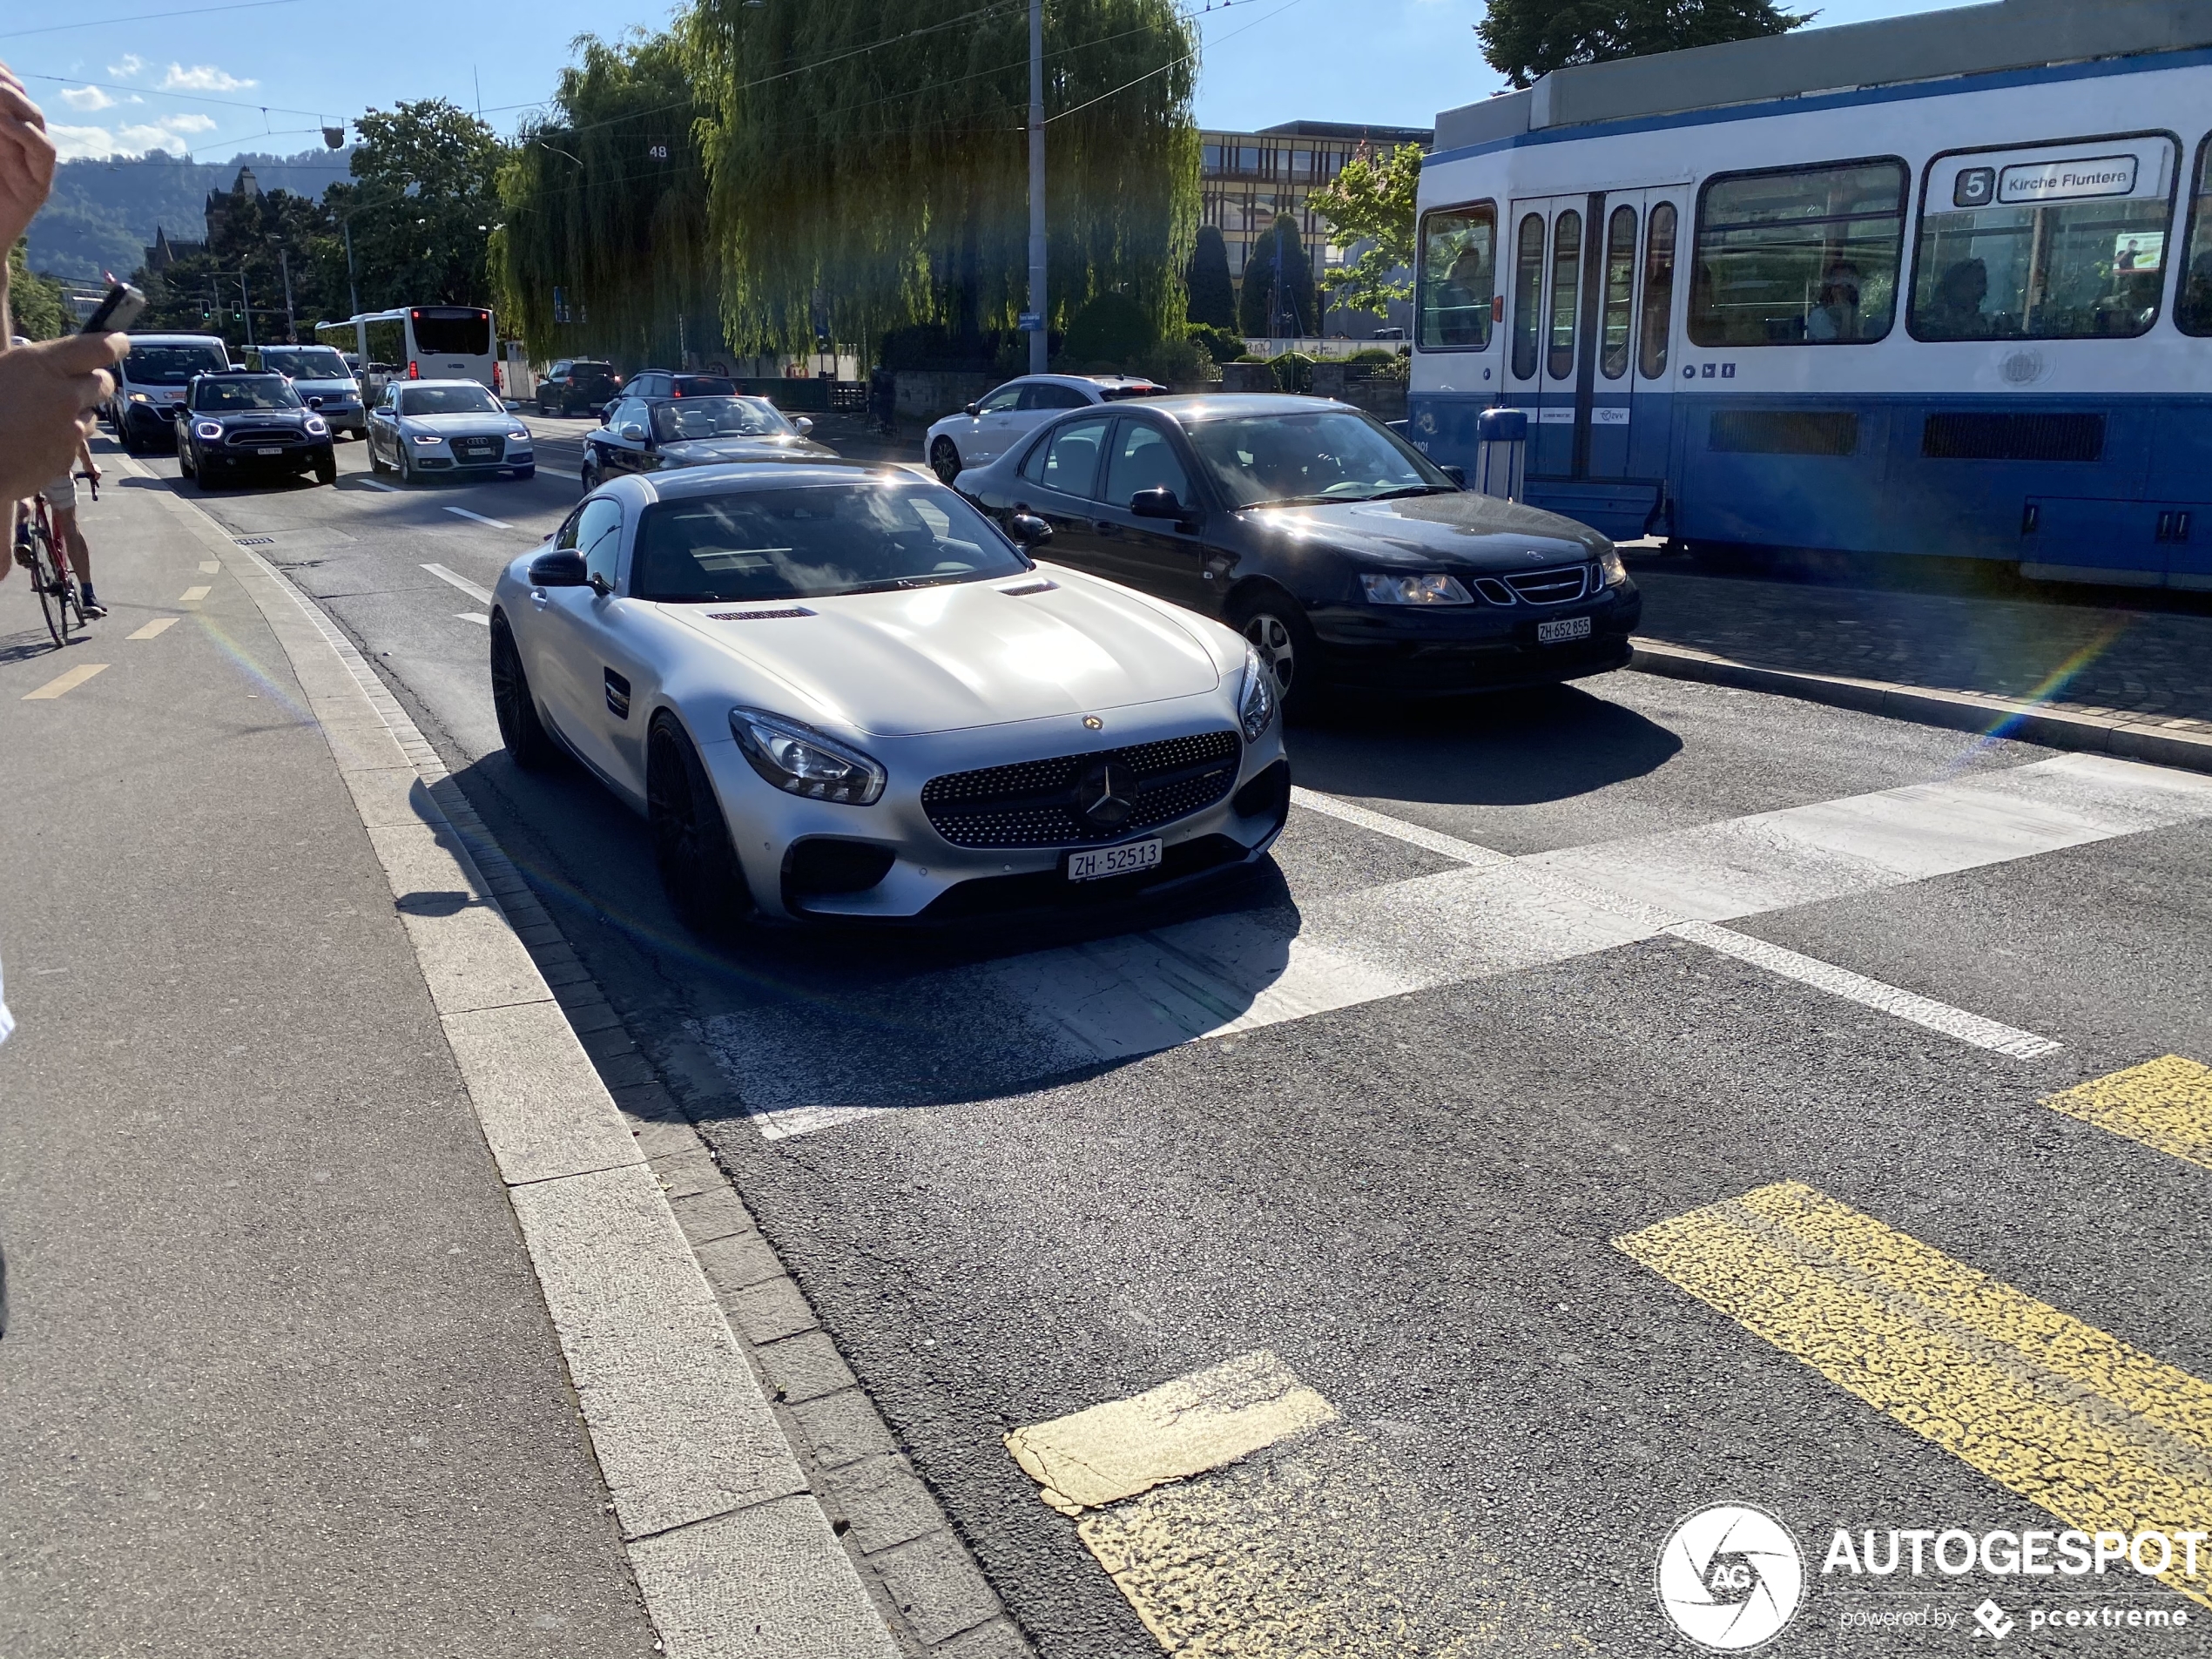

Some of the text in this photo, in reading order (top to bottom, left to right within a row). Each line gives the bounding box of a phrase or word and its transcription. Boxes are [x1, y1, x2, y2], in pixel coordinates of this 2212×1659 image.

[649, 145, 667, 158] 48
[1966, 172, 1985, 198] 5
[2008, 176, 2057, 192] Kirche
